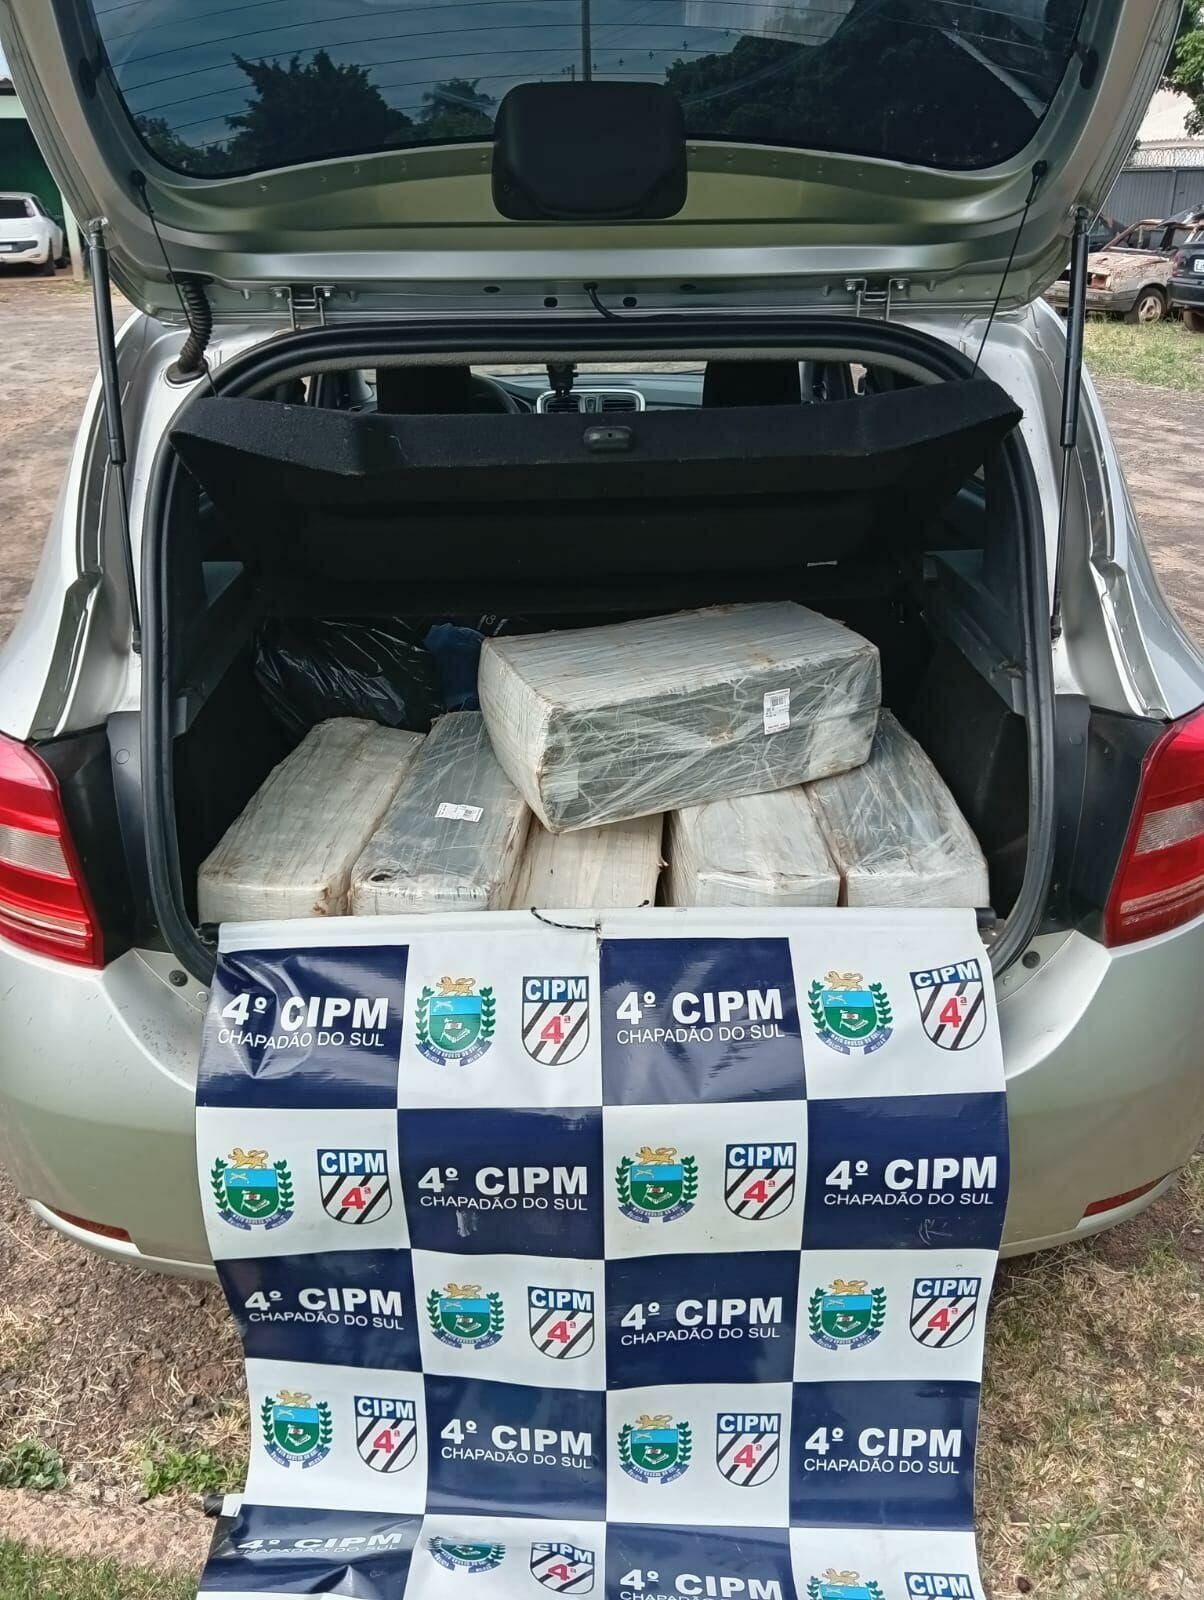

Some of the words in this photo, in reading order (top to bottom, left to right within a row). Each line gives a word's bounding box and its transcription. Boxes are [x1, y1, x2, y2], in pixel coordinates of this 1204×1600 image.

[914, 959, 980, 988] CIPM
[524, 978, 587, 1000] CIPM
[222, 993, 267, 1025] 4º
[280, 996, 388, 1031] CIPM
[616, 991, 656, 1024] 4º
[672, 988, 783, 1026] CIPM
[217, 1028, 312, 1050] CHAPADÃO
[317, 1032, 345, 1046] DO
[350, 1033, 384, 1047] SUL
[616, 1026, 713, 1044] CHAPADÃO
[719, 1026, 745, 1042] DO
[750, 1023, 785, 1039] SUL
[320, 1151, 385, 1175] CIPM
[728, 1145, 794, 1168] CIPM
[418, 1167, 458, 1193] 4º
[475, 1166, 587, 1195] CIPM
[825, 1160, 869, 1190] 4º
[884, 1156, 997, 1190] CIPM
[420, 1195, 517, 1211] CHAPADÃO
[523, 1197, 549, 1211] DO
[553, 1197, 588, 1211] SUL
[824, 1191, 923, 1206] CHAPADÃO
[928, 1192, 955, 1205] DO
[959, 1192, 993, 1205] SUL
[916, 1278, 978, 1296] CIPM
[245, 1290, 282, 1311] 4º
[298, 1287, 402, 1317] CIPM
[530, 1288, 591, 1311] CIPM
[249, 1311, 339, 1325] CHAPADÃO
[344, 1314, 368, 1327] DO
[372, 1317, 404, 1330] SUL
[620, 1302, 660, 1331] 4º
[675, 1297, 782, 1326] CIPM
[621, 1327, 713, 1346] CHAPADÃO
[719, 1327, 744, 1340] DO
[748, 1326, 780, 1339] SUL
[357, 1398, 413, 1419] CIPM
[719, 1415, 778, 1432] CIPM
[440, 1419, 477, 1444] 4º
[491, 1425, 592, 1456] CIPM
[805, 1427, 844, 1455] 4º
[858, 1428, 962, 1457] CIPM
[441, 1447, 528, 1465] CHAPADÃO
[533, 1453, 557, 1466] DO
[561, 1456, 592, 1470] SUL
[804, 1457, 894, 1474] CHAPADÃO
[899, 1460, 923, 1474] DO
[928, 1460, 960, 1475] SUL
[294, 1533, 402, 1548] CIPM
[534, 1543, 592, 1563] CIPM
[619, 1568, 659, 1591] 4º
[675, 1573, 783, 1600] CIPM
[909, 1574, 971, 1597] CIPM
